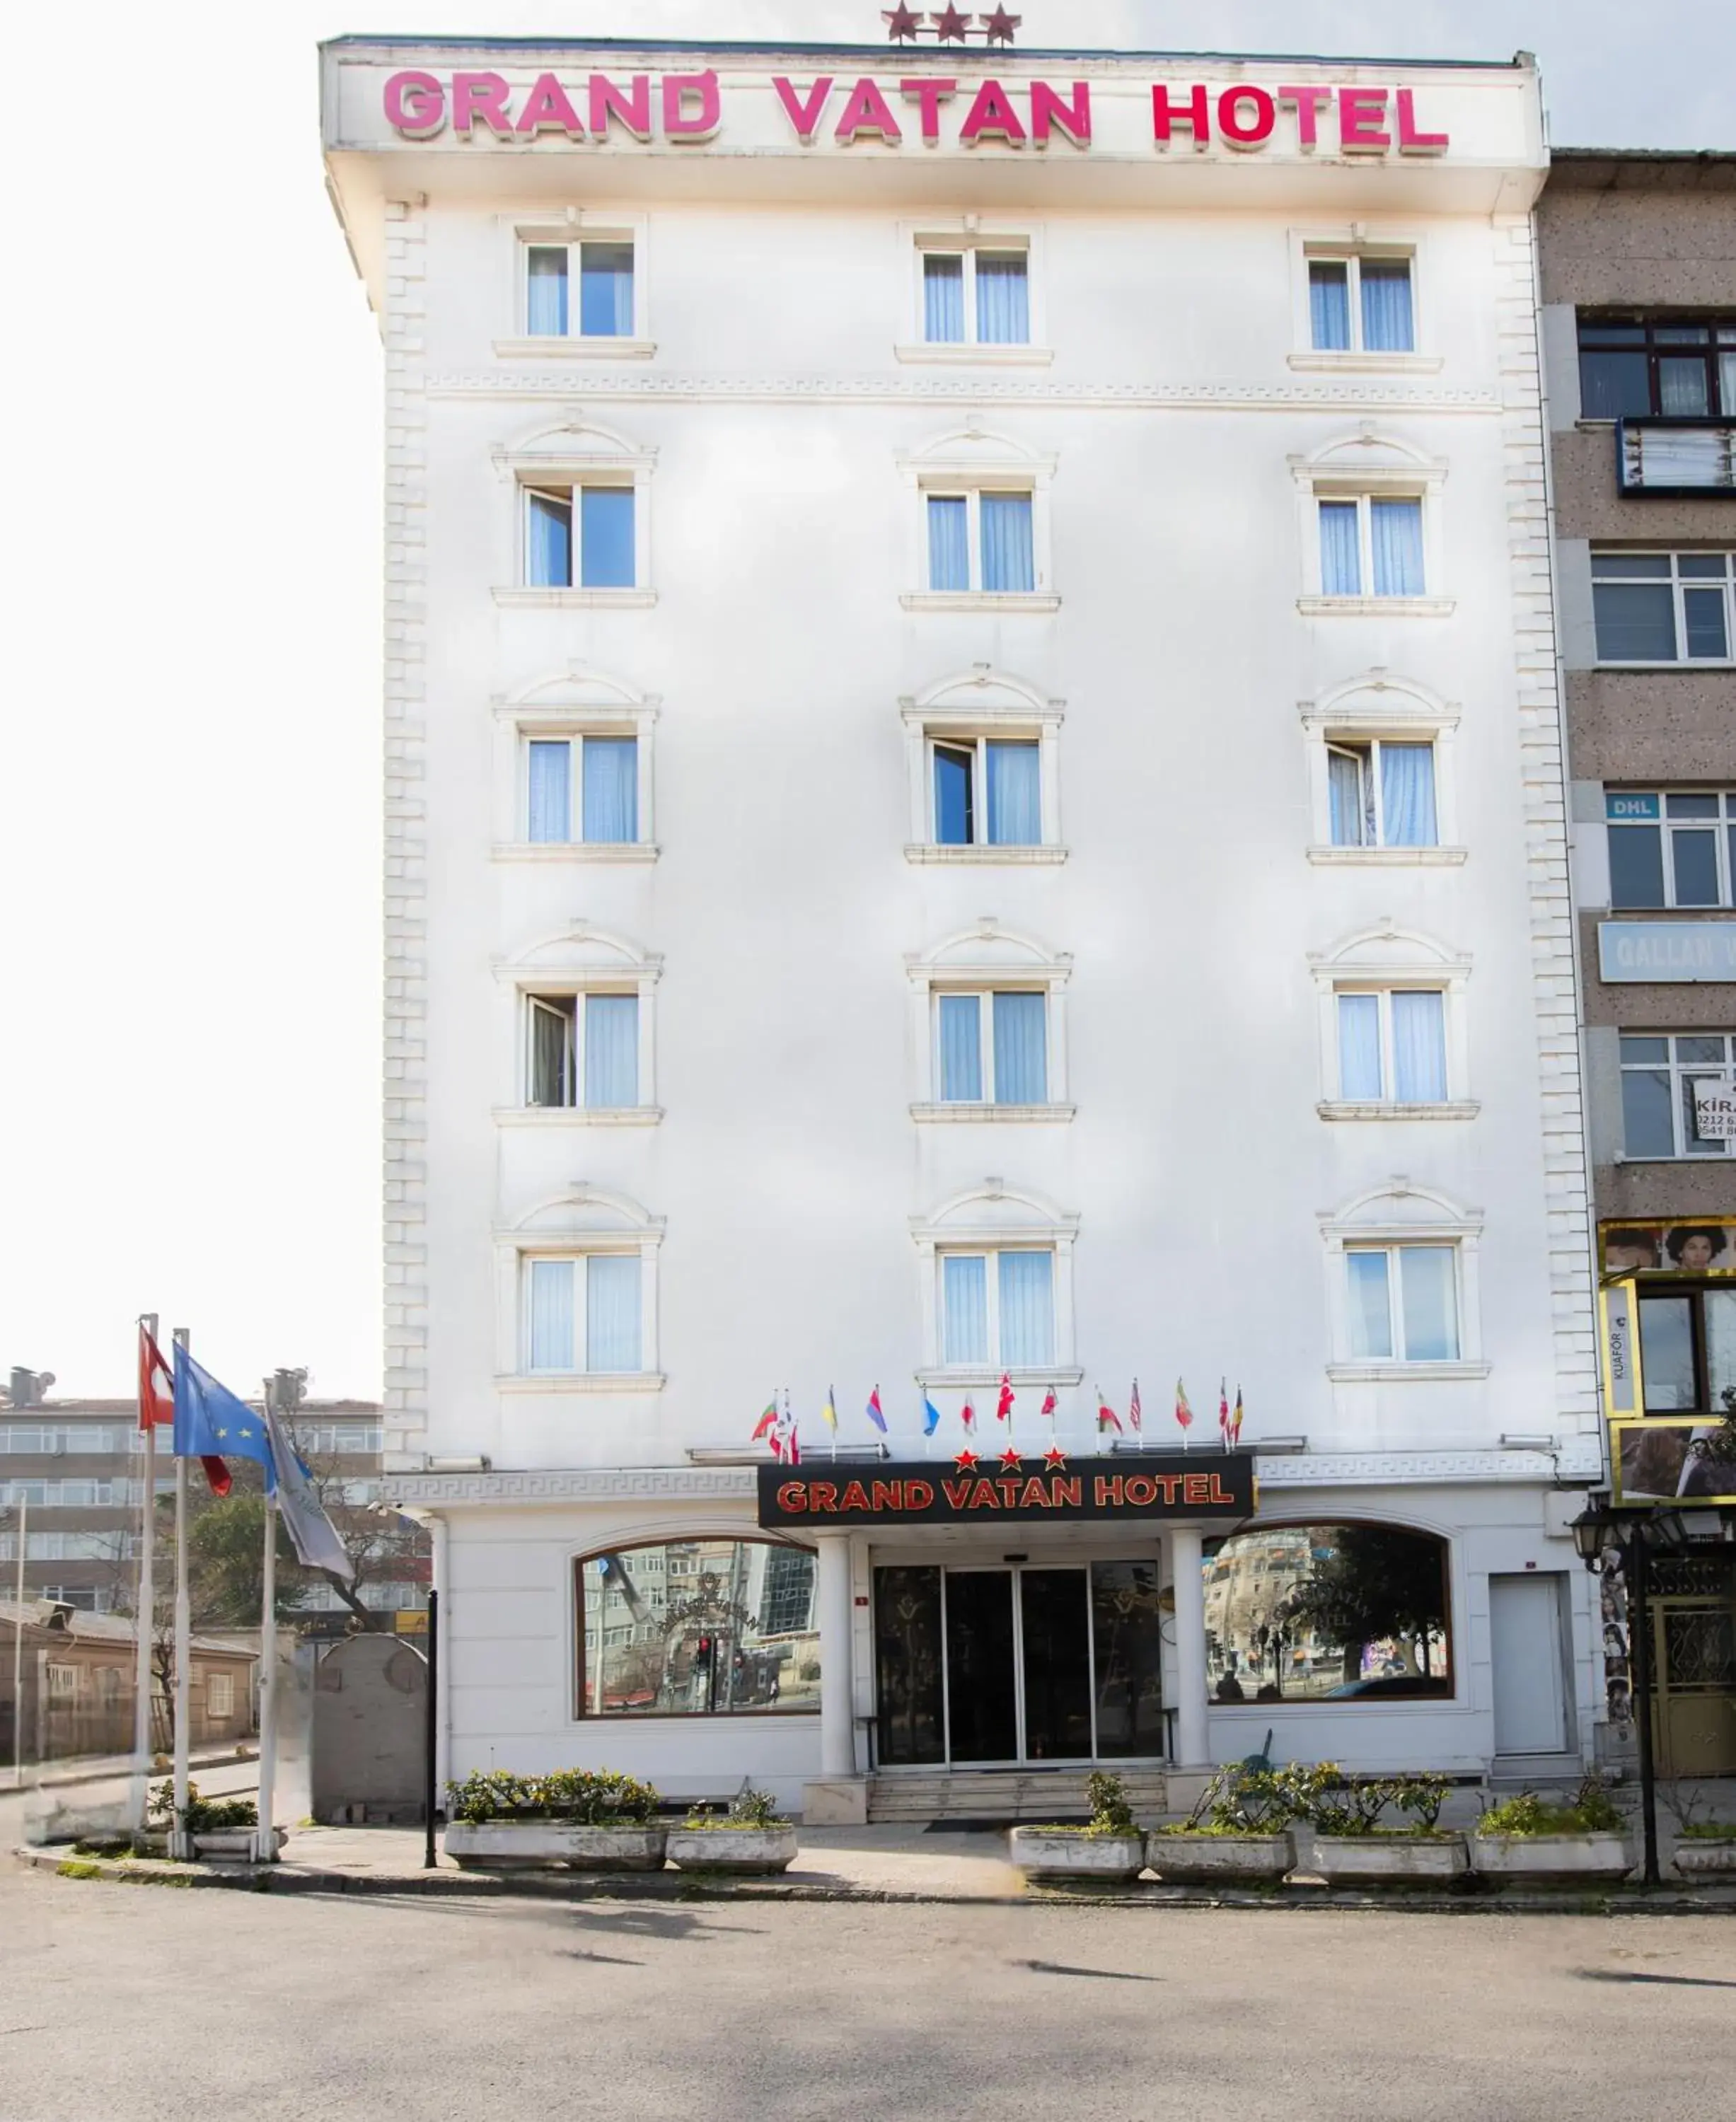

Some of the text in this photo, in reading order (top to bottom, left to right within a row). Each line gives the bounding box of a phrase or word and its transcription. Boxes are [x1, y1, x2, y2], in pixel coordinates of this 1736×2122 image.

[383, 69, 1449, 154] GRAND VATAN HOTEL
[1614, 801, 1653, 815] DHL
[1697, 1097, 1736, 1113] KİR
[777, 1473, 1234, 1514] GRAND VATAN HOTEL
